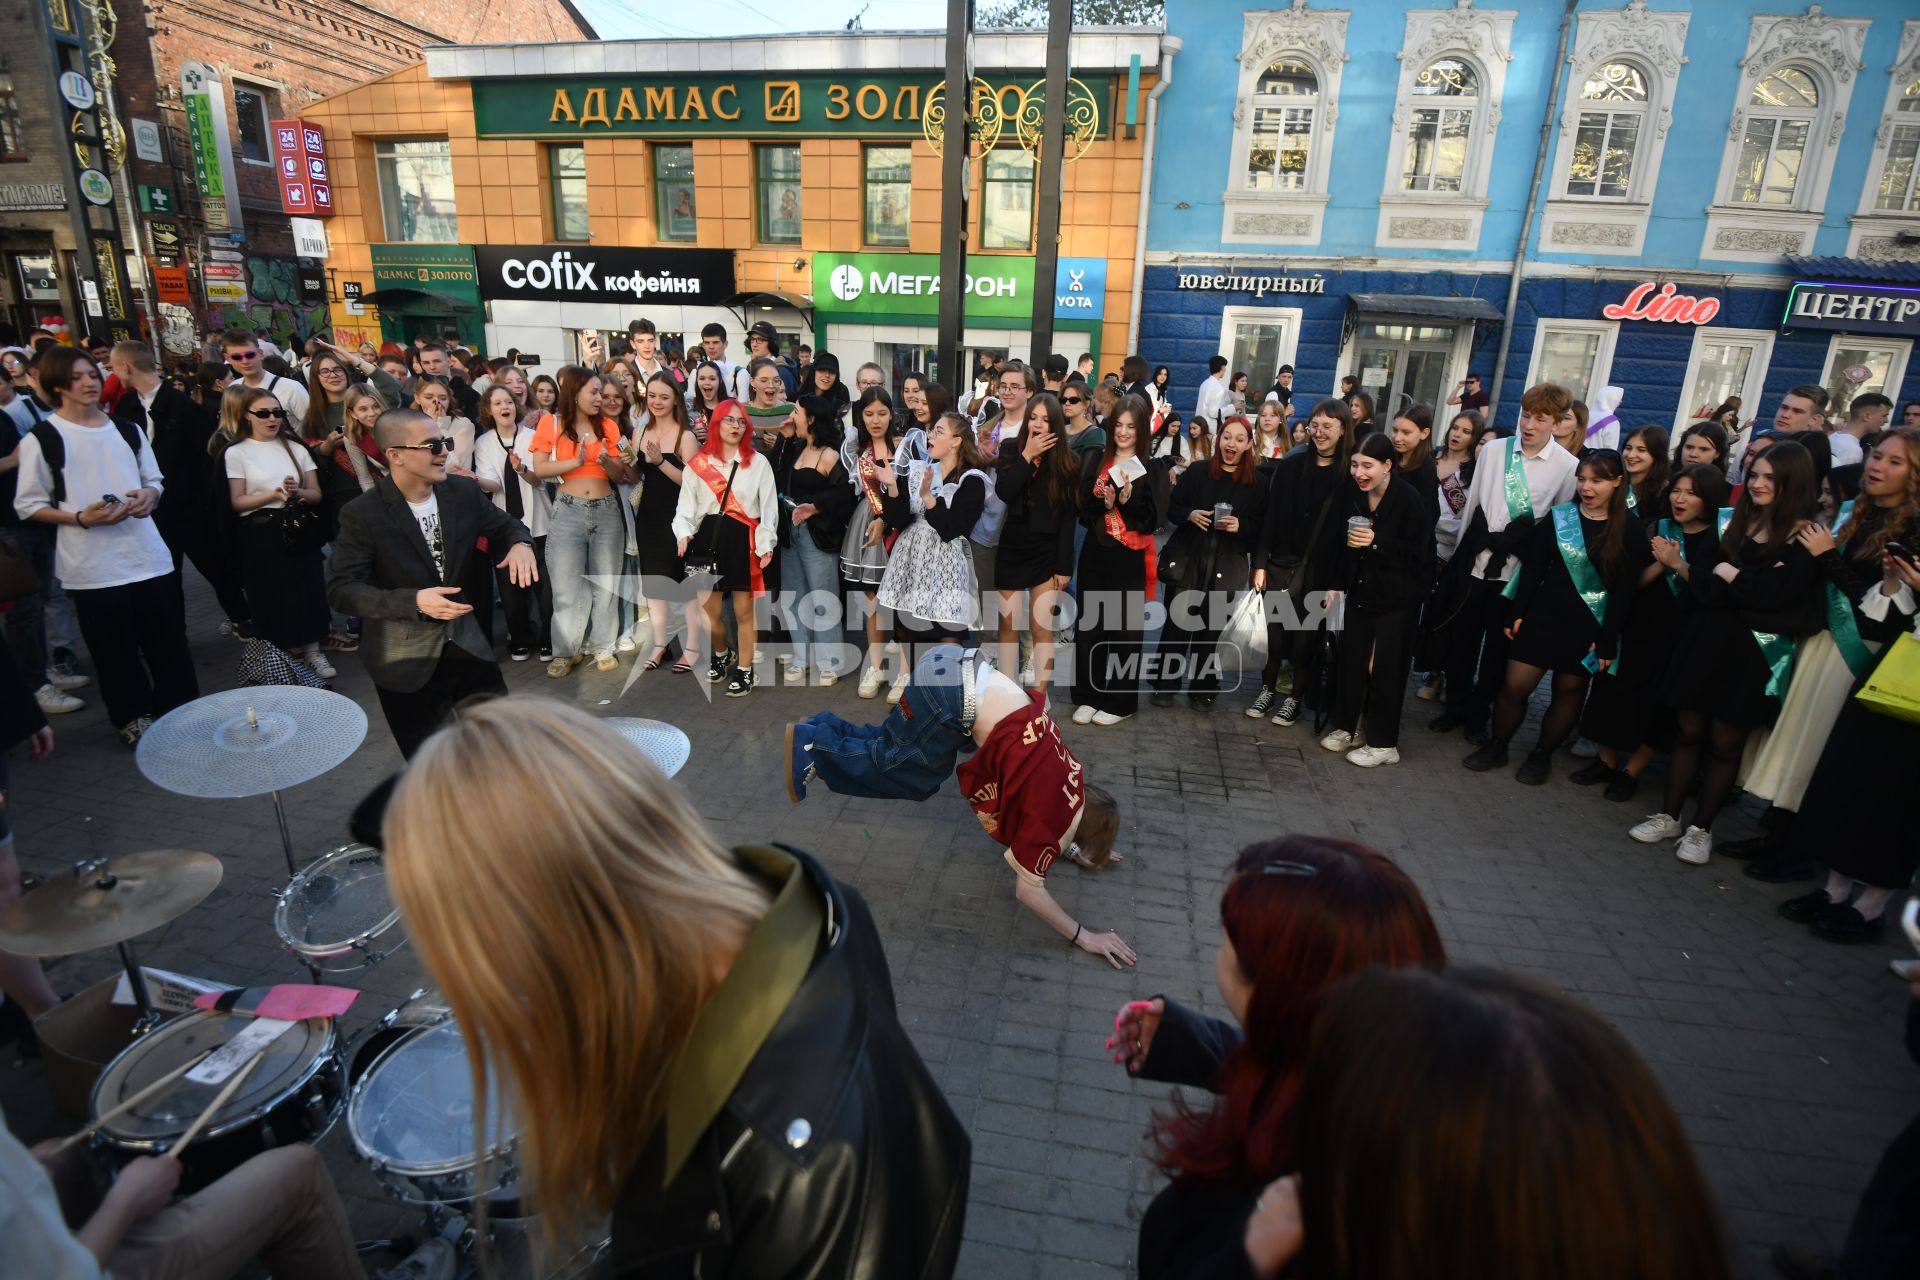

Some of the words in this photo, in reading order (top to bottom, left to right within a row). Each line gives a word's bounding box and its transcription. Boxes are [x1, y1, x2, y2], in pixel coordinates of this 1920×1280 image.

[549, 84, 741, 128] АДАМАС
[199, 97, 222, 193] АПТЕКА
[280, 131, 294, 143] 24
[306, 132, 320, 145] 24
[307, 143, 321, 152] ЧАСА
[153, 223, 176, 232] ЧАСЫ
[376, 270, 415, 281] АДАМАС
[430, 270, 473, 281] ЗОЛОТО
[501, 251, 599, 291] cofix
[604, 269, 701, 299] кофейня
[1178, 272, 1327, 299] ювелирный
[1056, 296, 1093, 309] YOTA
[1602, 281, 1721, 326] Lino
[1790, 290, 1920, 324] ЦЕНТР
